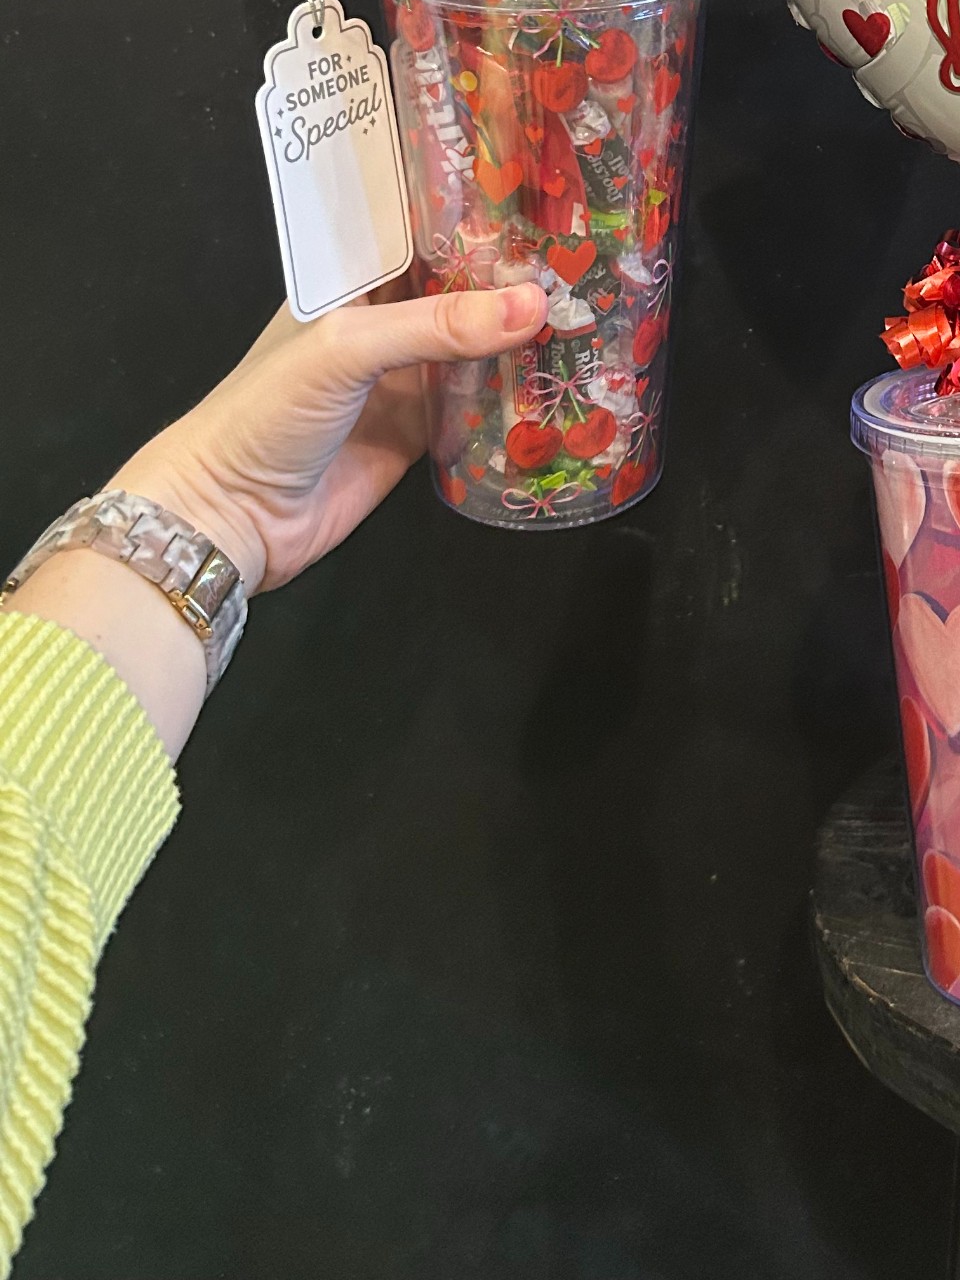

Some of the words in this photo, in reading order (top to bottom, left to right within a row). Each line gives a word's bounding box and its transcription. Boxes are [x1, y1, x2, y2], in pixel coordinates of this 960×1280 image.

[286, 64, 370, 112] SOMEONE
[307, 52, 343, 81] FOR
[284, 82, 383, 163] Special
